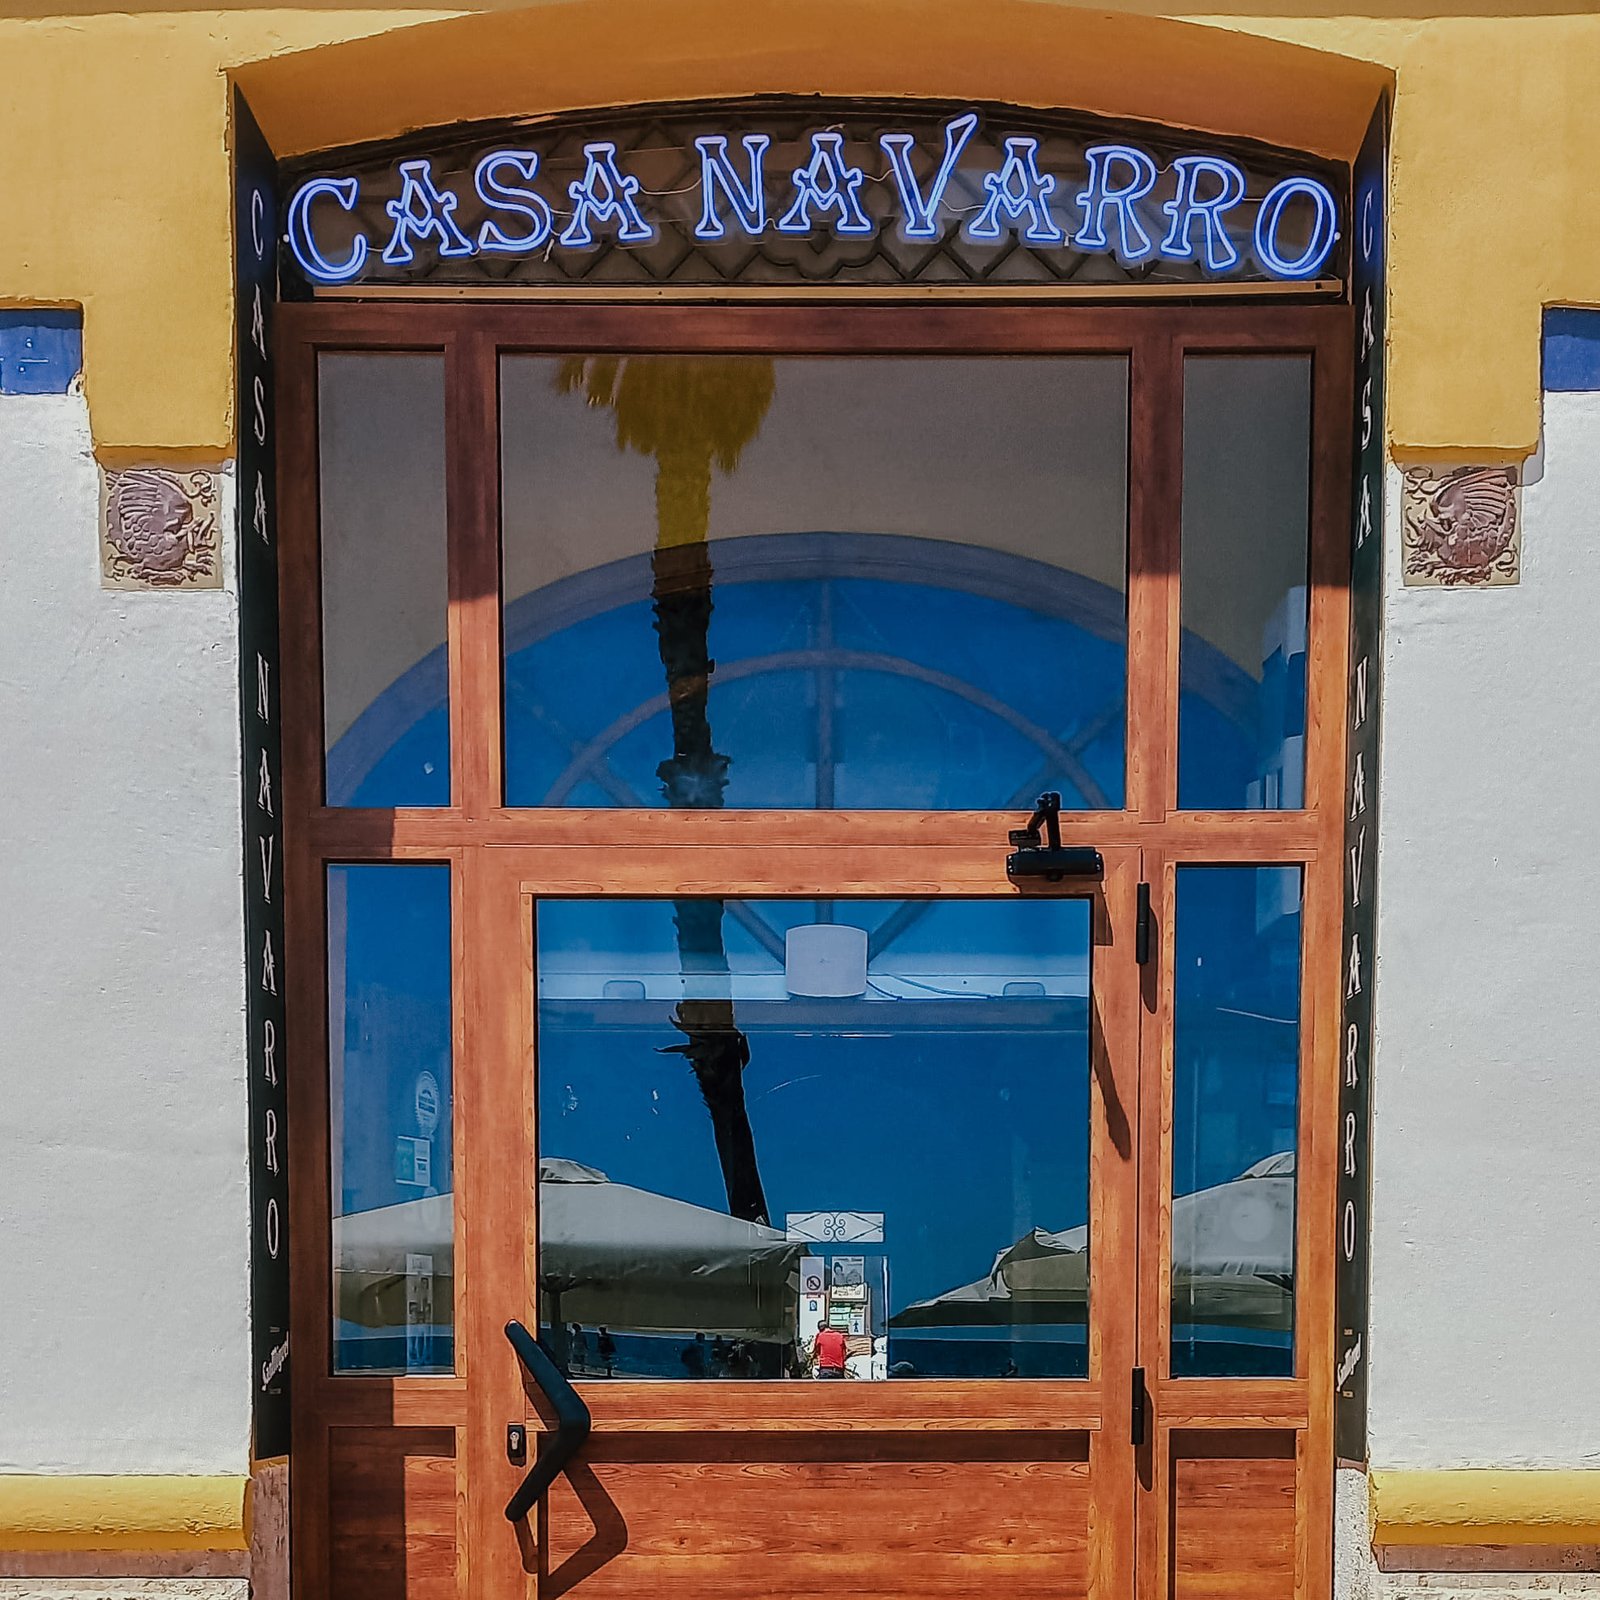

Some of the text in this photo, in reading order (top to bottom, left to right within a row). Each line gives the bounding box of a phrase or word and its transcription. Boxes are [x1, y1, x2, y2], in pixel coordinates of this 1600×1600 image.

[251, 187, 278, 1259] CASA NAVARRO
[287, 112, 1338, 280] CASA NAVARRO
[1342, 188, 1375, 1261] CASA NAVARRO
